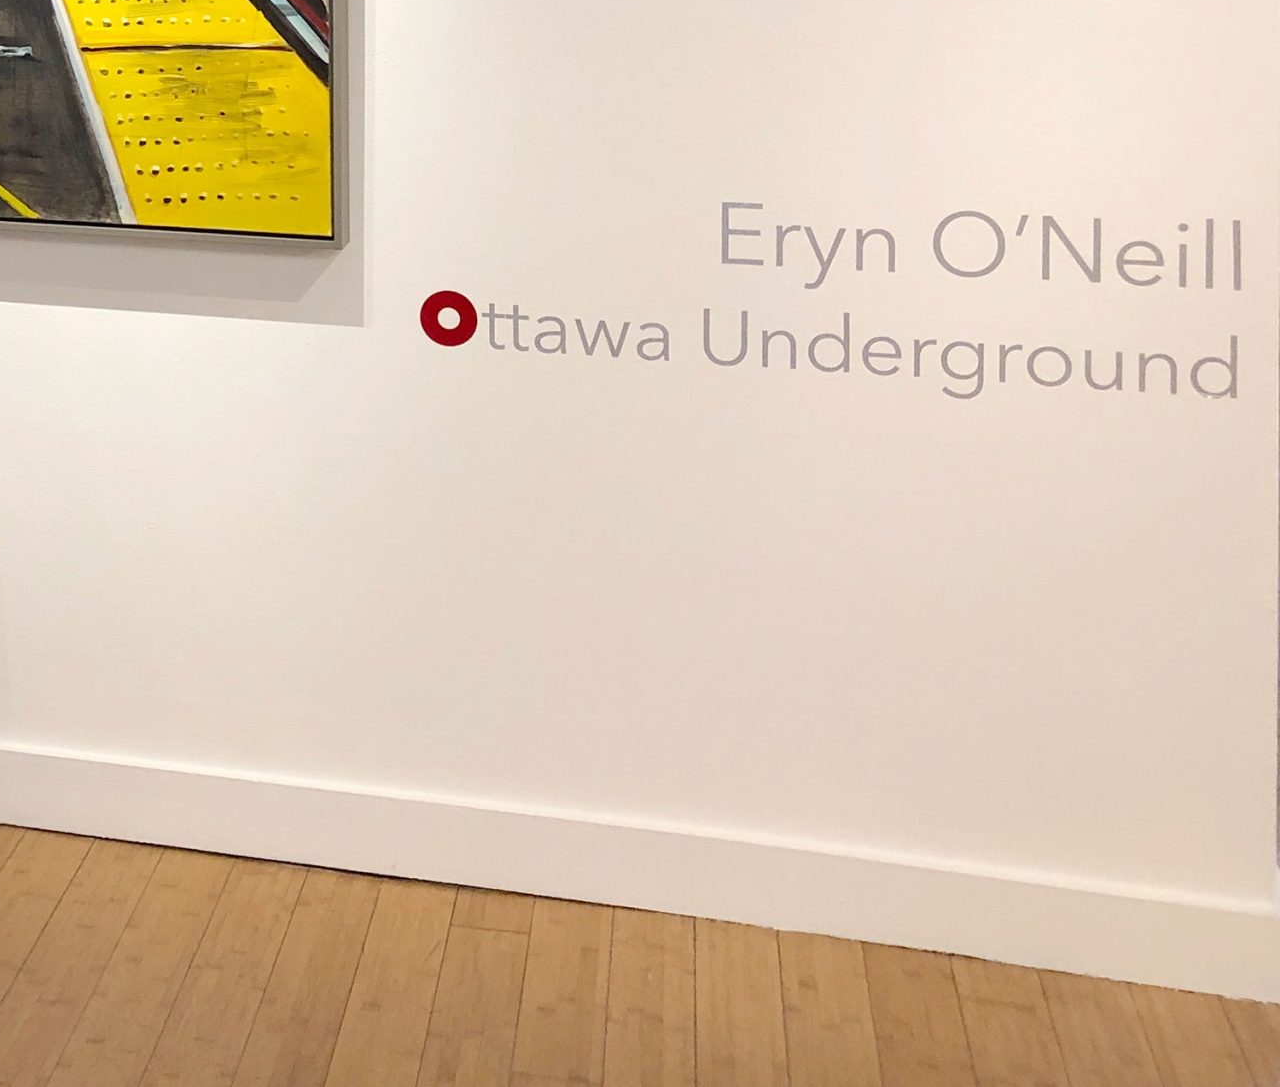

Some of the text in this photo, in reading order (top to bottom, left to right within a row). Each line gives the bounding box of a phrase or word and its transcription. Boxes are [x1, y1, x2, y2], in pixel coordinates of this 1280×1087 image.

[722, 202, 1242, 292] Eryn O'Neill
[419, 290, 1239, 400] Ottawa Underground
